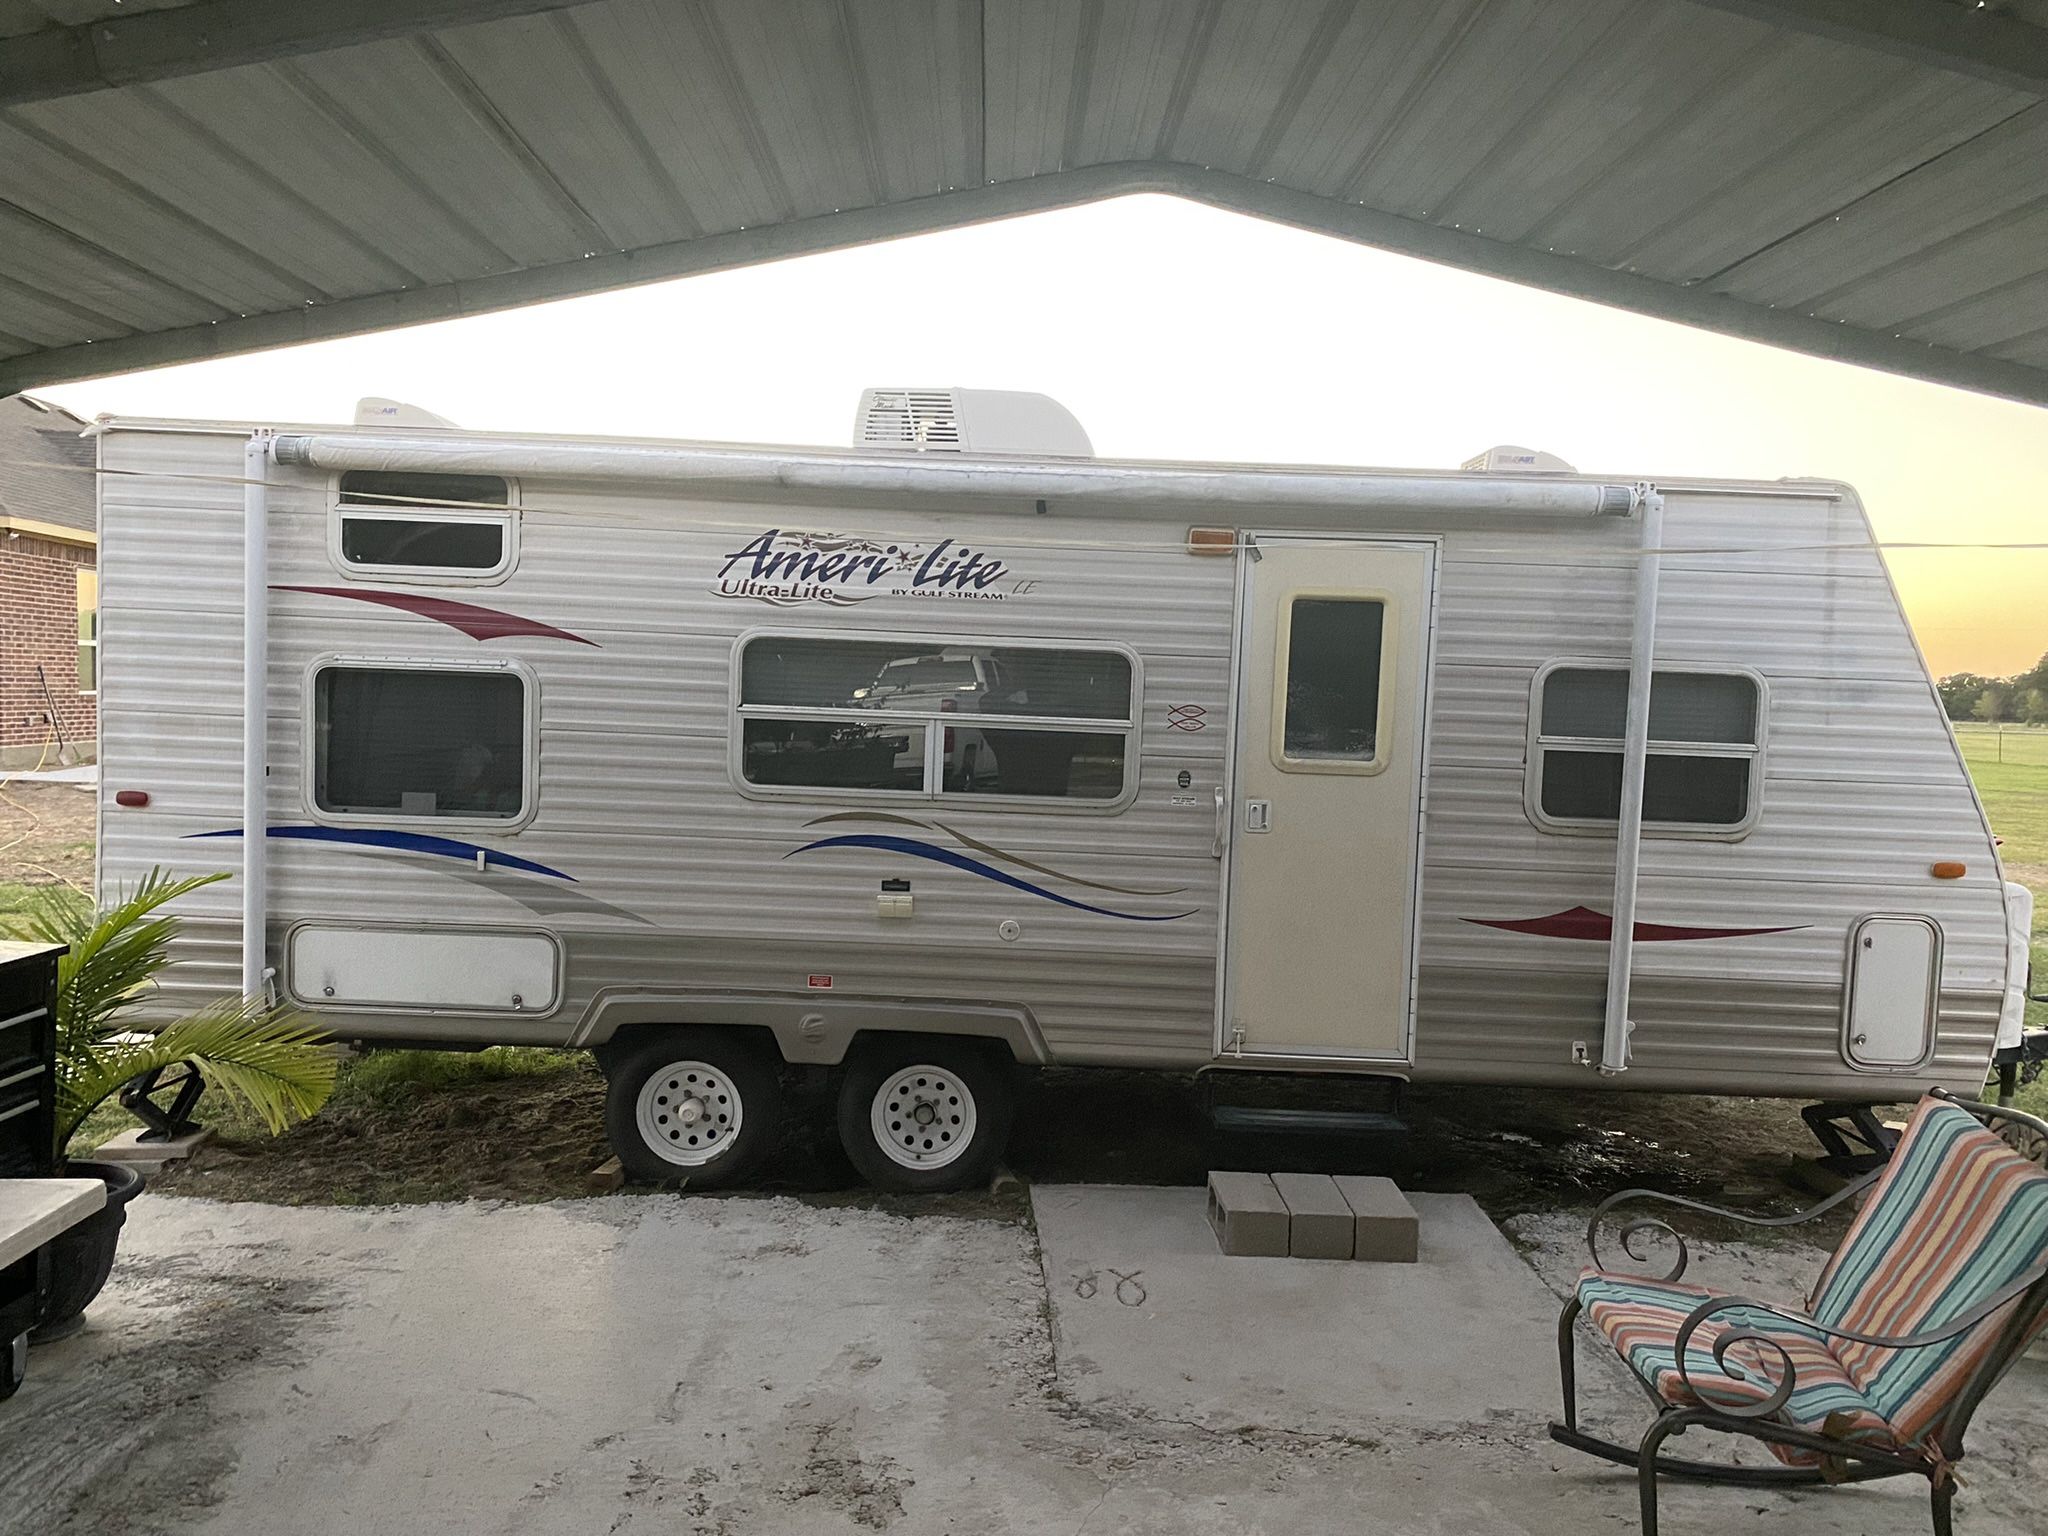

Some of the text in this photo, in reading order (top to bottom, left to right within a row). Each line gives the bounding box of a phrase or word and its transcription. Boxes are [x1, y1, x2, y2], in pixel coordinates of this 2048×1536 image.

[717, 529, 1009, 590] Ameri Lite
[720, 578, 833, 600] Ultra-Lite
[891, 588, 1003, 600] BY GULF STREAM
